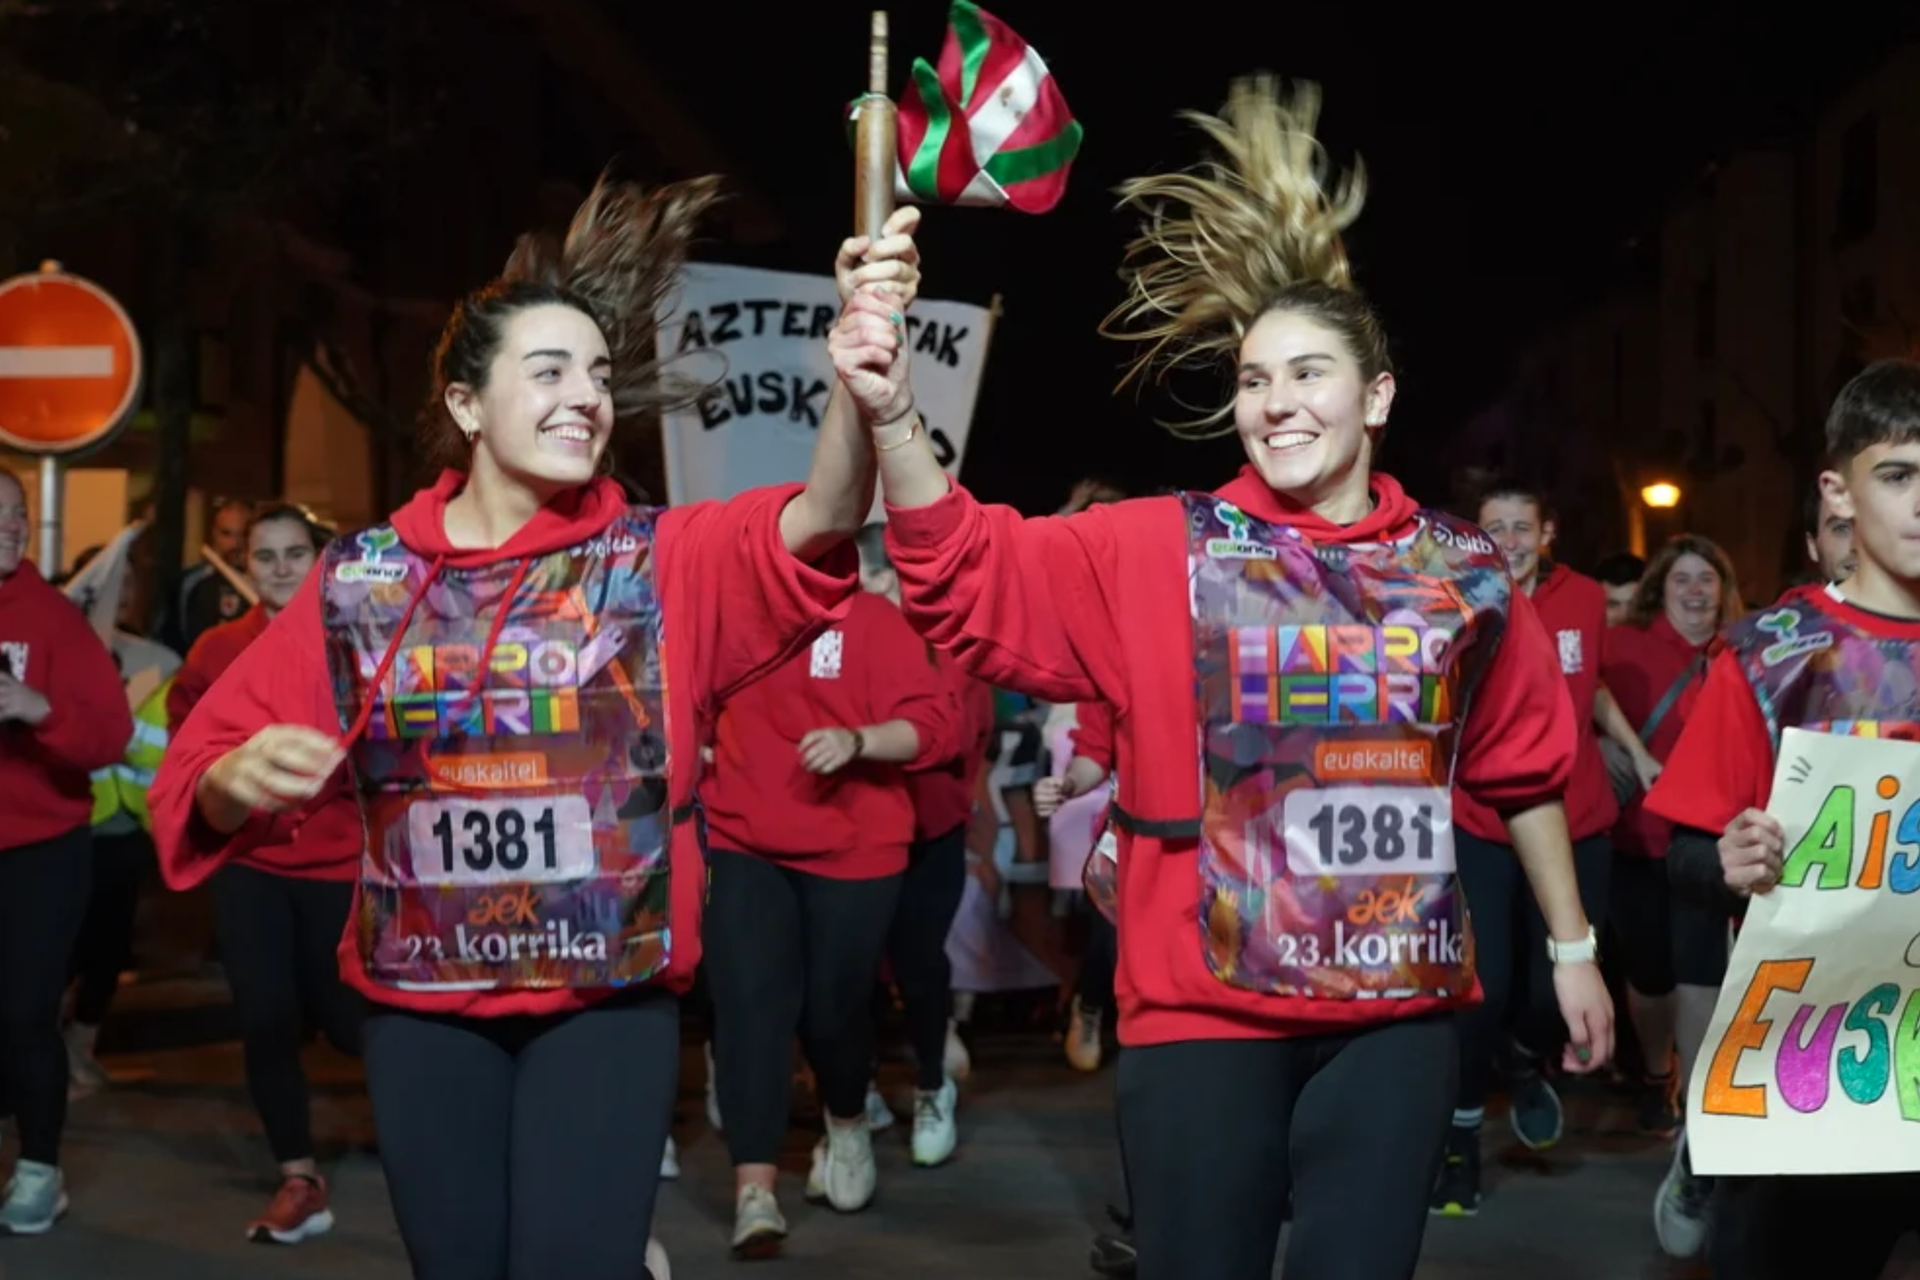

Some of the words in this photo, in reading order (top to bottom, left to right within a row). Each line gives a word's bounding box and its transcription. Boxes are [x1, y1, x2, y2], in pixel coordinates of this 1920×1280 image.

[439, 757, 538, 782] euskaltel
[1323, 743, 1425, 771] euskaltel
[432, 807, 558, 873] 1381
[1308, 804, 1434, 866] 1381
[468, 885, 541, 924] aek
[1347, 878, 1424, 924] aek
[455, 919, 607, 963] korrika
